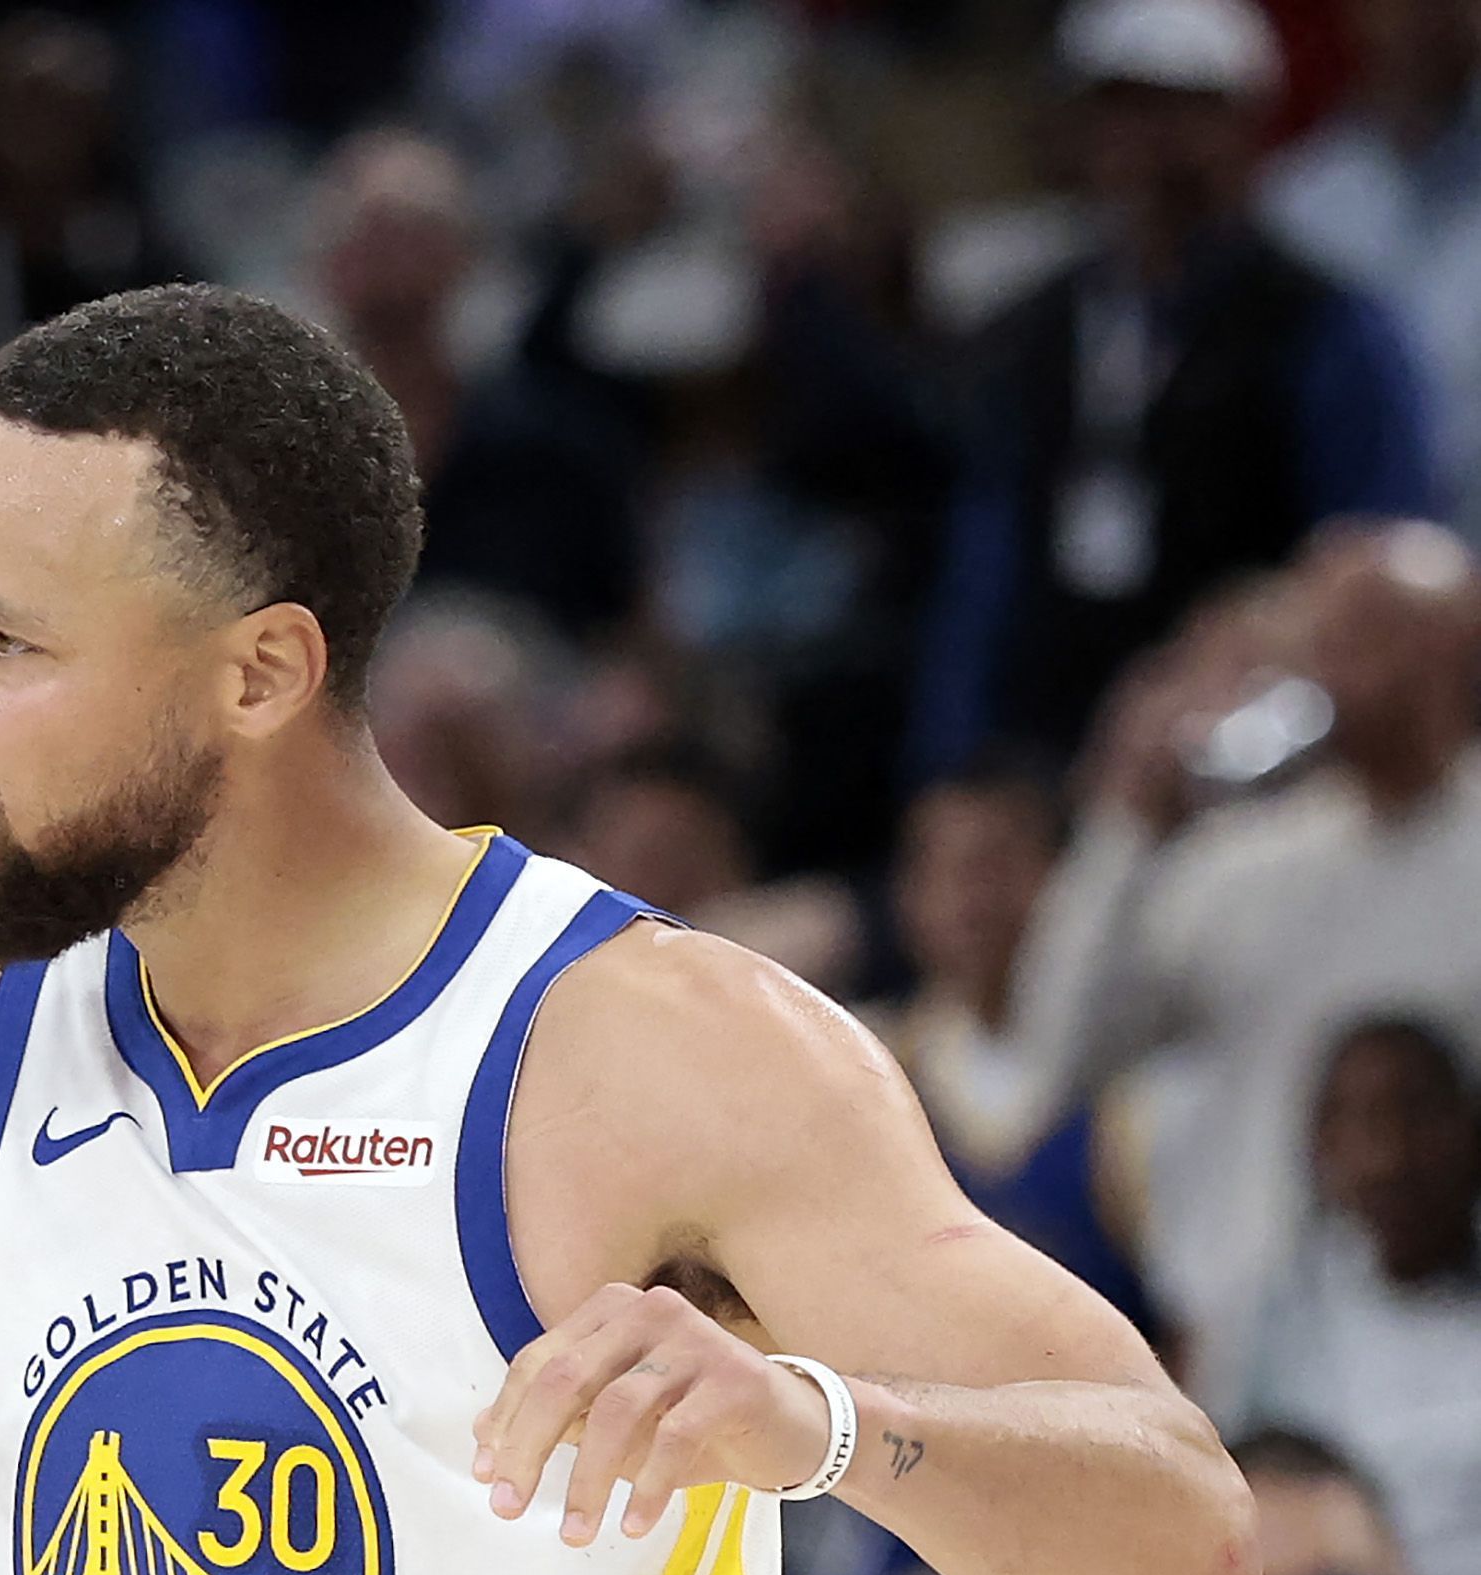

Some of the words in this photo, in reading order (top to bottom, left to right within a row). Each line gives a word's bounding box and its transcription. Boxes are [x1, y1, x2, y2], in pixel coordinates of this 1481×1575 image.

[264, 1125, 433, 1167] Rakuten
[23, 1257, 227, 1398] GOLDEN
[255, 1271, 387, 1420] STATE
[198, 1438, 336, 1572] 30
[815, 1433, 851, 1489] FAITH
